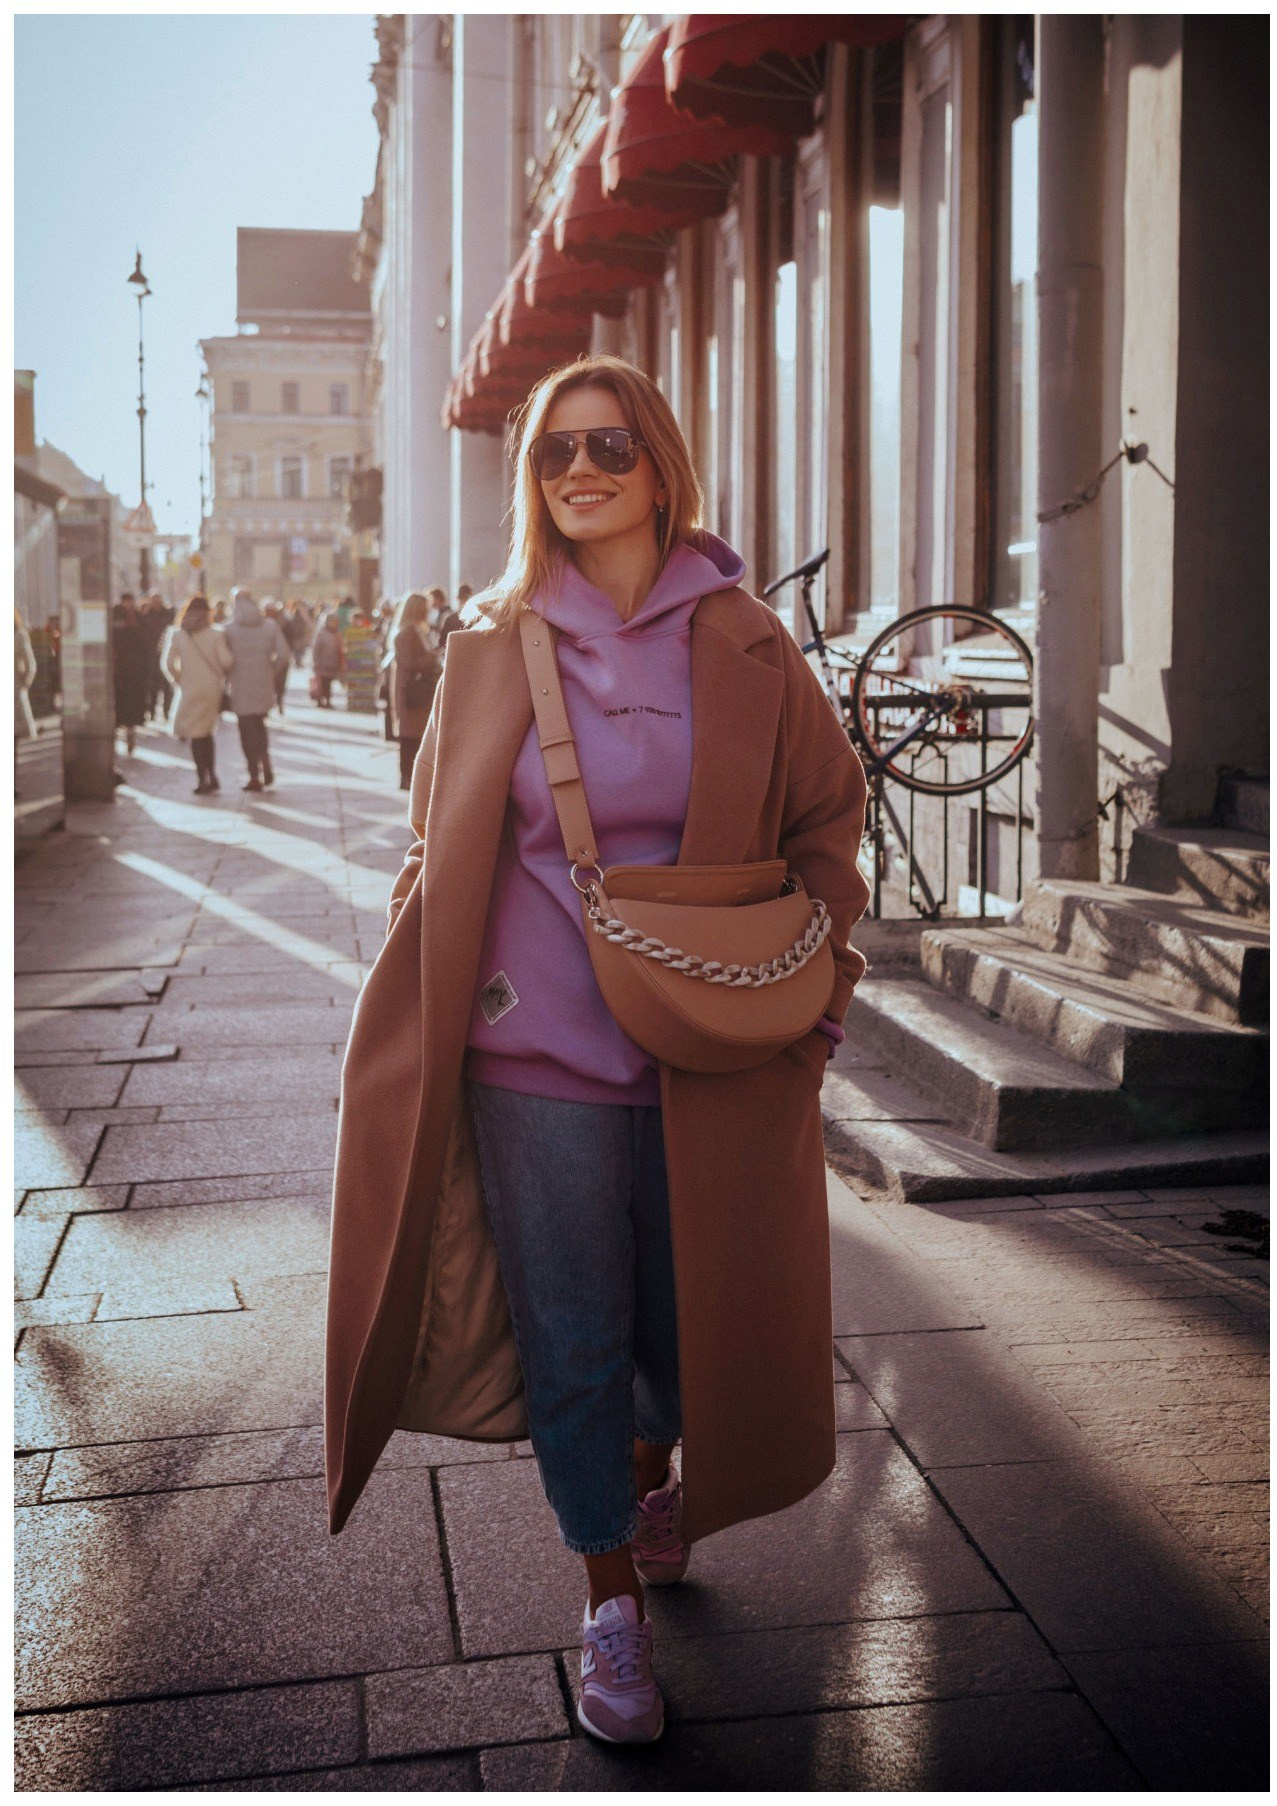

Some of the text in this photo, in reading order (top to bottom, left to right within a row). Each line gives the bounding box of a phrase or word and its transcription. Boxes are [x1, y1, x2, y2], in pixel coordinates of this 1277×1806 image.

[604, 709, 619, 717] CALL
[620, 706, 630, 714] ME
[638, 705, 643, 713] 7
